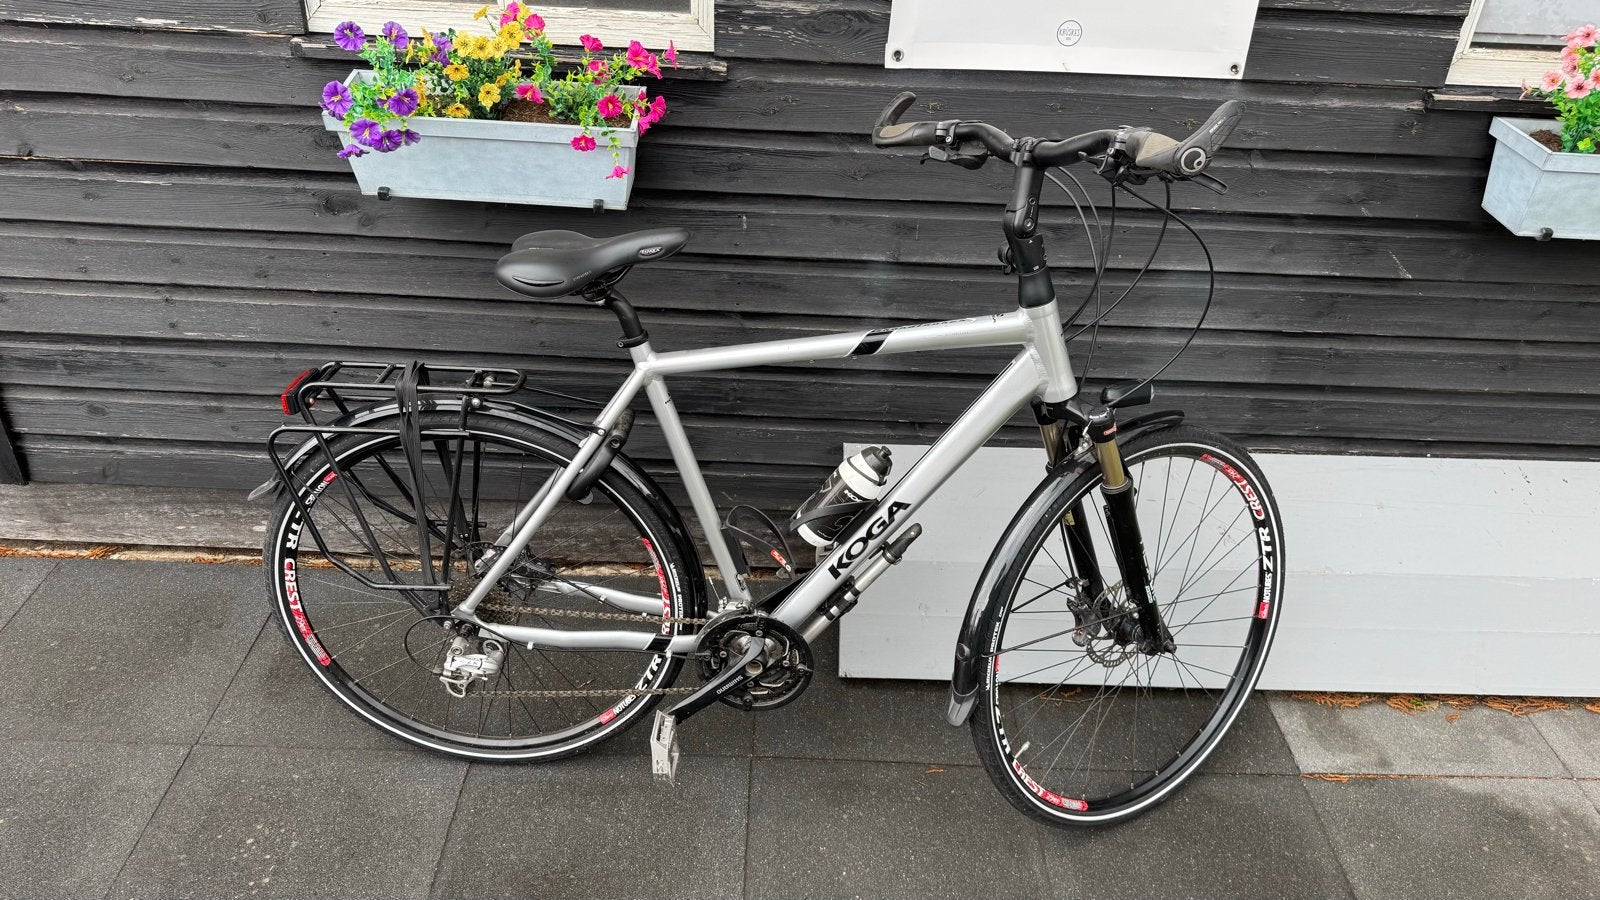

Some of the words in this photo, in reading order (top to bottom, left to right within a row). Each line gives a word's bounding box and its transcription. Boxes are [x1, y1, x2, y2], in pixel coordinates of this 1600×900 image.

[1234, 480, 1265, 521] CREST
[286, 508, 309, 550] TR
[828, 501, 912, 580] KOGA
[1258, 526, 1274, 573] ZTR
[284, 558, 303, 613] CREST
[635, 654, 662, 693] ZTR
[716, 675, 744, 695] SHIMANO
